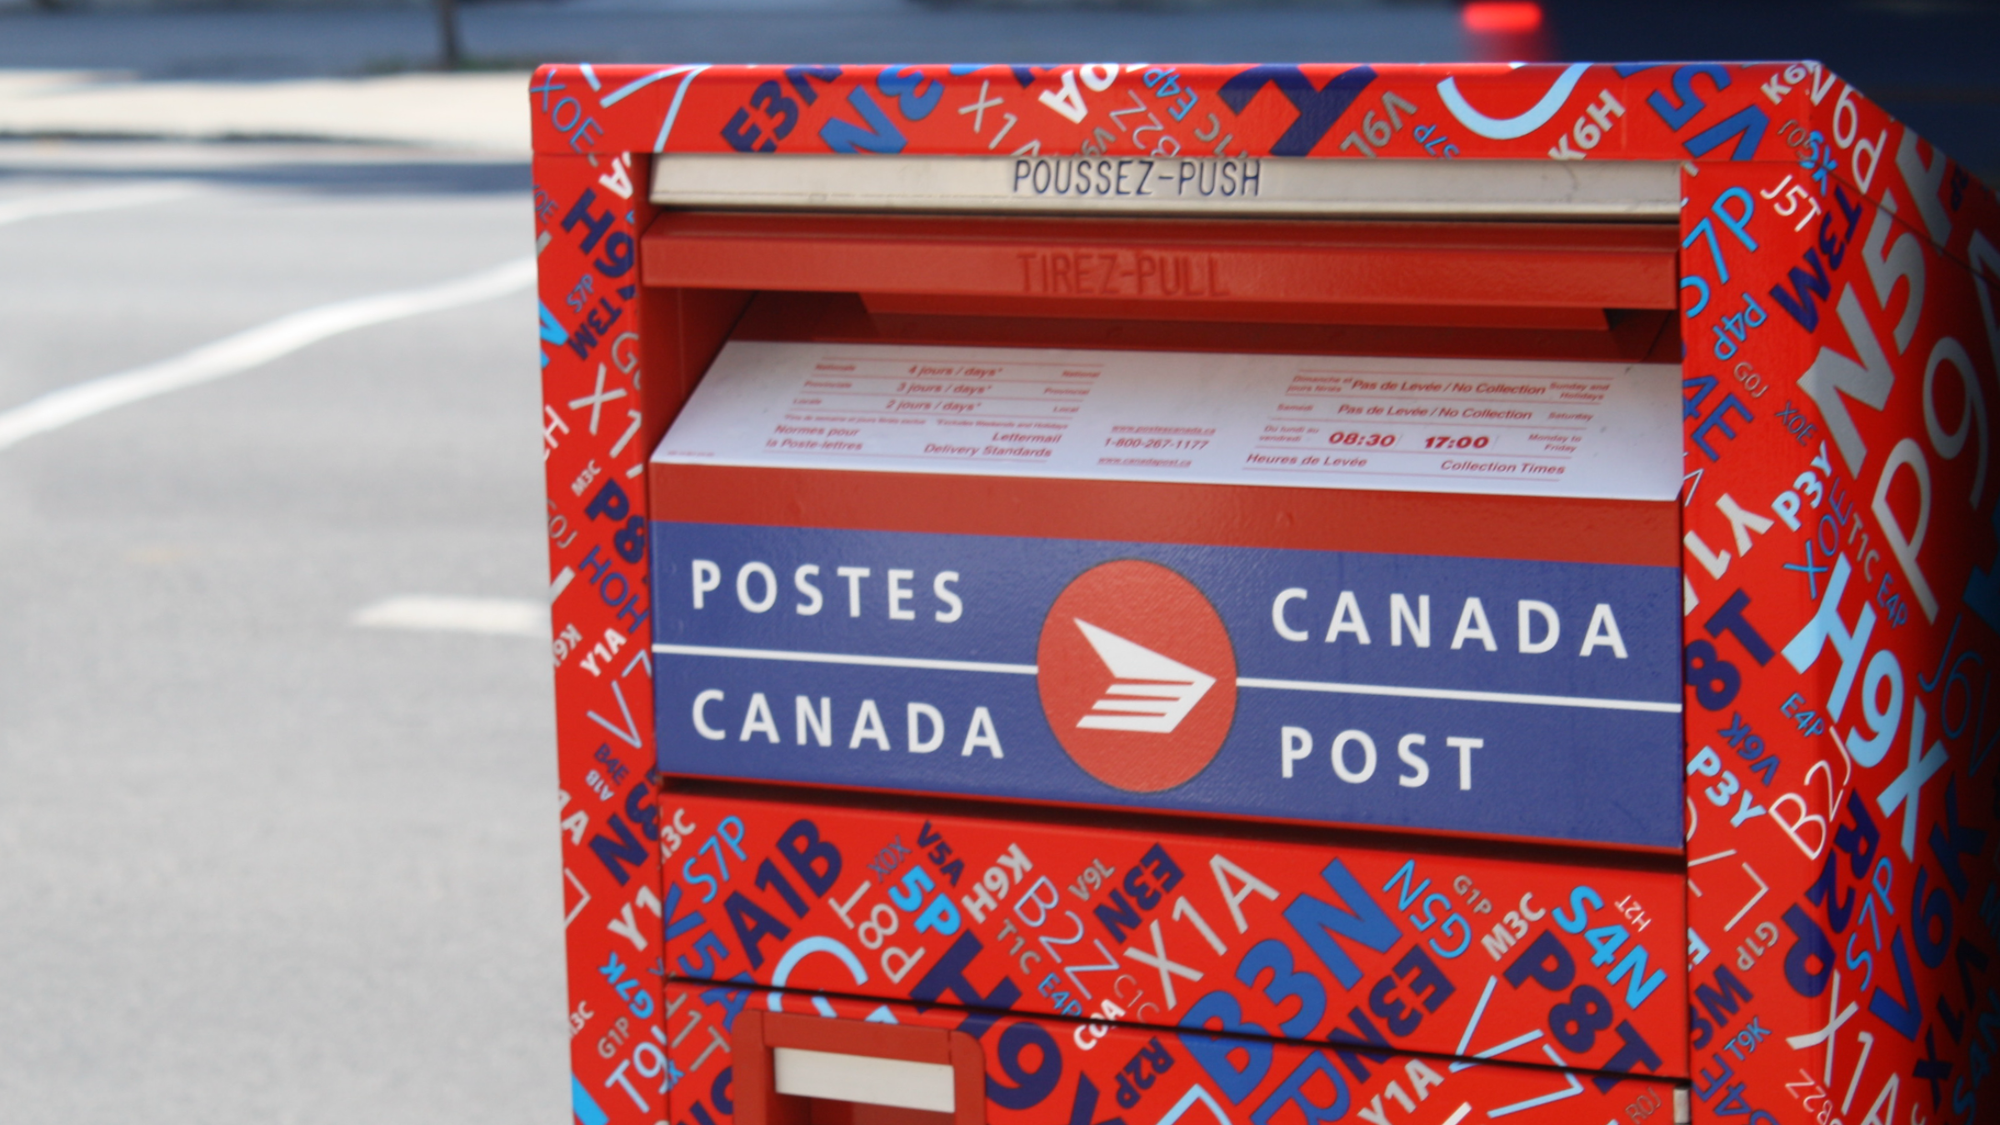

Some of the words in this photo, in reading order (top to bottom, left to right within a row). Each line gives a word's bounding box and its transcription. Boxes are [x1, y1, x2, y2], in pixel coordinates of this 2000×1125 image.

[1547, 88, 1625, 160] K6H
[1013, 159, 1261, 197] POUSSEZ-PUSH
[1759, 173, 1823, 233] J5T
[1016, 253, 1231, 297] TIREZ-PULL
[567, 296, 624, 362] T3M
[907, 383, 942, 395] jours
[918, 366, 954, 378] jours
[1352, 379, 1377, 390] Pas
[1380, 380, 1398, 391] de
[1401, 381, 1442, 392] Levée
[1452, 383, 1472, 393] No
[1476, 383, 1546, 395] Collection
[775, 425, 825, 435] Normes
[827, 427, 860, 437] pour
[896, 401, 931, 412] jours
[1337, 404, 1364, 415] Pas
[1366, 405, 1384, 415] de
[1387, 405, 1429, 417] Levée
[1438, 407, 1459, 417] No
[1462, 408, 1533, 420] Collection
[781, 438, 863, 450] Poste-lettres
[924, 443, 980, 456] Delivery
[982, 444, 1053, 457] Standards
[992, 432, 1062, 443] Lettermail
[1104, 437, 1210, 449] 1-800-267-1177
[1246, 453, 1298, 465] Heures
[1300, 454, 1320, 466] de
[1323, 455, 1368, 467] Levée
[1328, 430, 1396, 447] 08:30
[1424, 435, 1490, 449] 17:00
[570, 459, 602, 498] M3C
[1441, 459, 1516, 473] Collection
[1520, 461, 1566, 475] Times
[1770, 439, 1833, 533] P3Y
[691, 558, 964, 623] POSTES
[1271, 586, 1629, 660] CANADA
[579, 627, 628, 678] Y1A
[691, 688, 1005, 759] CANADA
[593, 742, 630, 786] B4E
[1281, 725, 1485, 791] POST
[1686, 744, 1768, 829] P3Y
[682, 815, 748, 904] S7P
[917, 819, 965, 888] V5A
[1066, 857, 1117, 902] V9L
[723, 818, 843, 972] A1B
[961, 842, 1034, 925] K6H
[1092, 842, 1185, 945] E3N
[1381, 859, 1473, 959] G5N
[1452, 873, 1494, 917] G1P
[827, 880, 927, 985] P8T
[1013, 875, 1120, 1000] B2Z
[1123, 853, 1281, 1012] X1A
[1480, 891, 1547, 962] M3C
[1613, 894, 1653, 933] H2T
[996, 918, 1042, 975] T1C
[1550, 885, 1668, 1010] S4N
[1735, 920, 1780, 972] G1P
[598, 950, 655, 1019] G7K
[1036, 972, 1082, 1018] E4P
[1175, 856, 1403, 1106] B3N
[597, 1016, 633, 1059] G1P
[1326, 942, 1456, 1084] E3N
[1502, 929, 1664, 1095] P8T
[1114, 1035, 1175, 1109] R2P
[1357, 1058, 1445, 1125] Y1A
